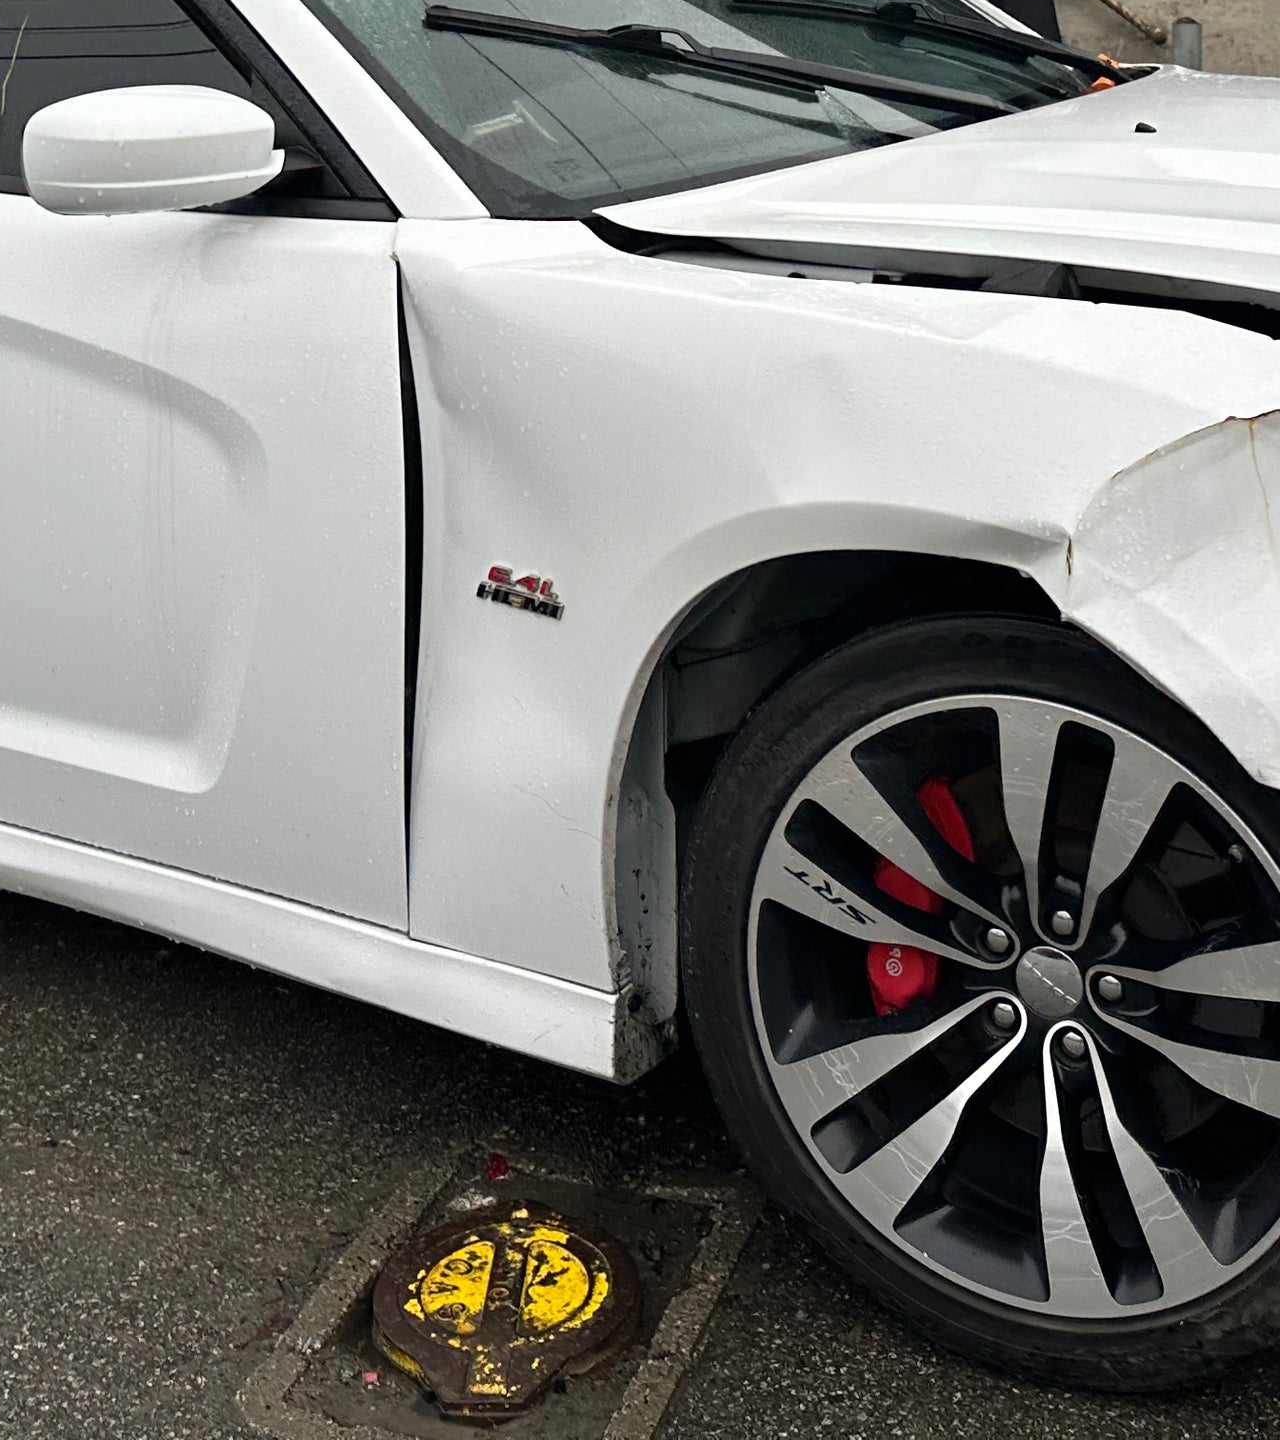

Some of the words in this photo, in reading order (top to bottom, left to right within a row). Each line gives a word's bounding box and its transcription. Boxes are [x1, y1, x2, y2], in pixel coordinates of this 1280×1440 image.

[475, 580, 566, 621] HEMI
[488, 564, 560, 600] 6.4L
[783, 865, 878, 925] SRT
